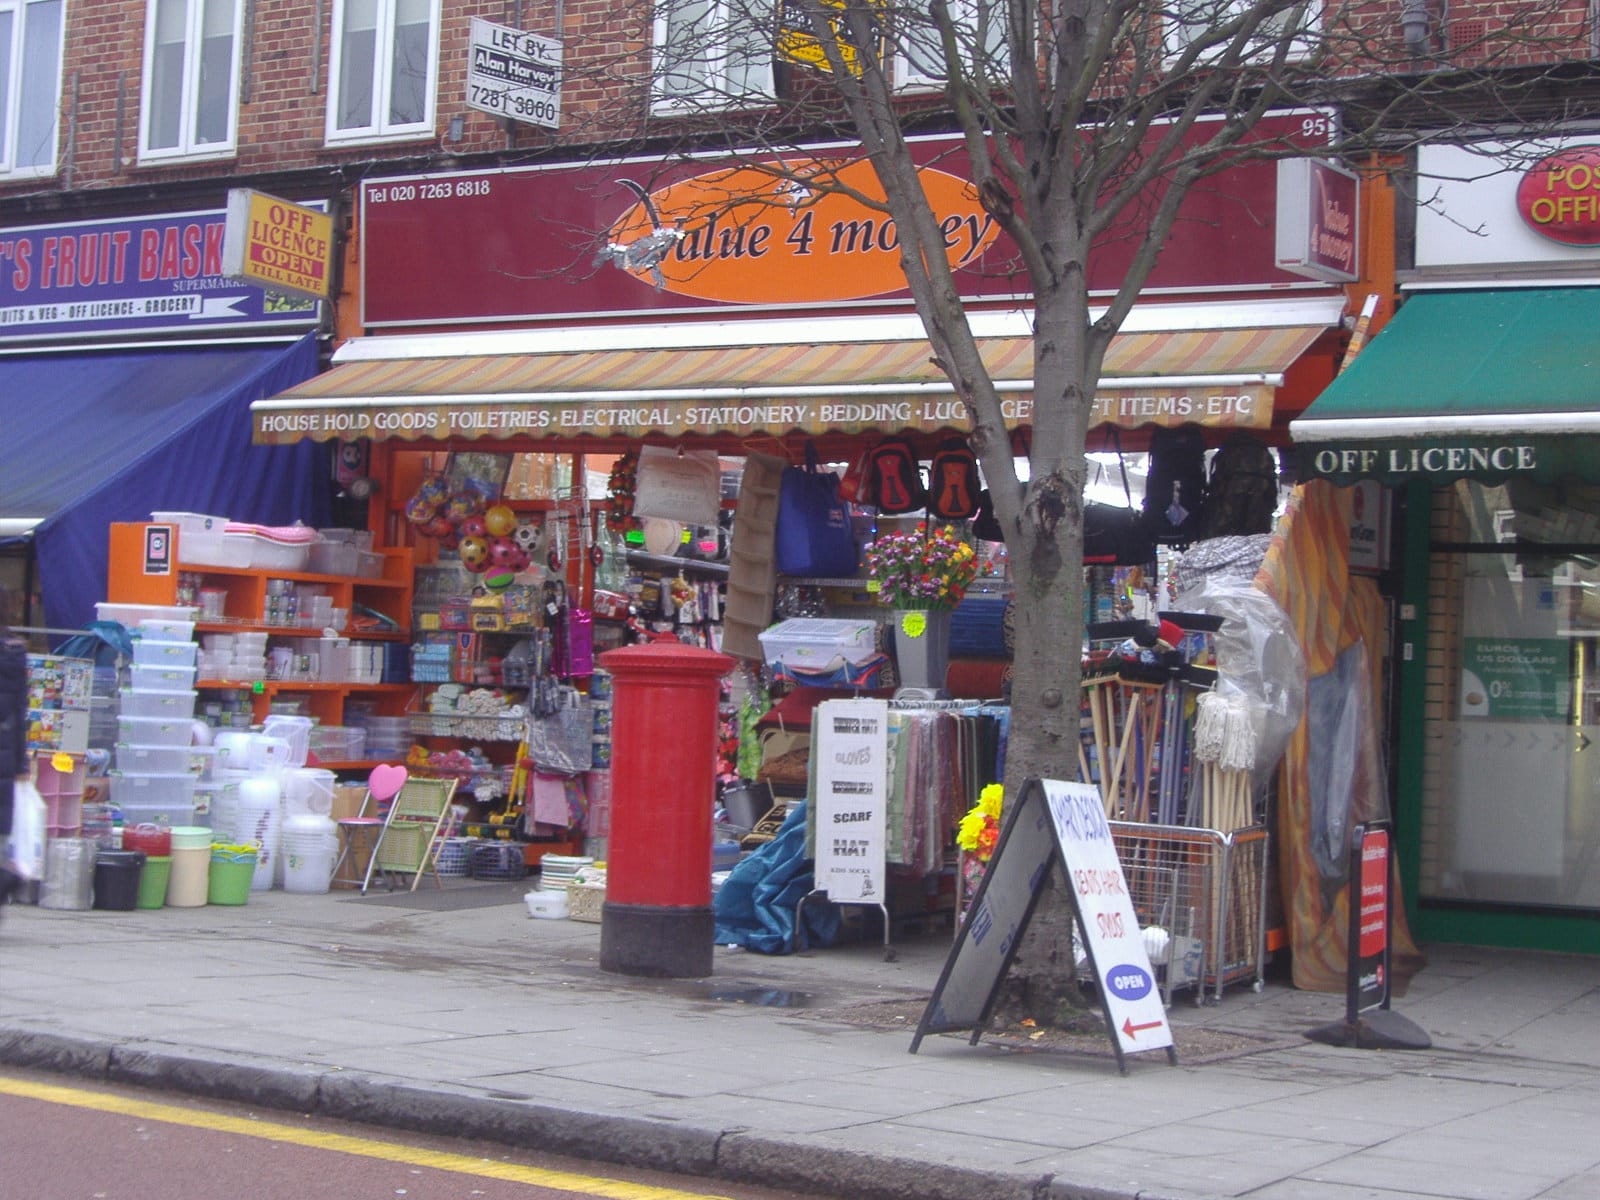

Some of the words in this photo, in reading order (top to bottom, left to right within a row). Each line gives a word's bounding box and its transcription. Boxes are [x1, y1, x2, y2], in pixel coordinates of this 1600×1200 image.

[492, 29, 520, 52] LET
[526, 39, 546, 59] BY
[476, 48, 505, 71] Alan
[509, 57, 554, 91] Harvey
[471, 85, 508, 112] 7281
[515, 96, 555, 121] 3000
[1302, 118, 1326, 137] 95
[368, 188, 387, 203] Tel
[390, 186, 416, 201] 020
[420, 183, 453, 199] 7263
[456, 180, 490, 197] 6818
[269, 205, 313, 234] OFF
[252, 220, 327, 260] LICENCE
[786, 211, 814, 255] 4
[830, 213, 993, 265] moey
[41, 230, 130, 289] FRUIT
[261, 247, 313, 276] OPEN
[252, 263, 283, 281] TILL
[287, 273, 321, 291] LATE
[39, 306, 57, 321] VEG
[69, 304, 88, 319] OFF
[90, 301, 134, 317] LICENCE
[145, 297, 196, 314] GROCERY
[261, 413, 320, 432] HOUSE
[324, 412, 371, 430] HOLD
[374, 411, 438, 429] GOODS
[448, 410, 550, 429] TOILETRIES
[560, 408, 674, 427] ELECTRICAL
[684, 405, 809, 425] STATIONERY
[820, 402, 912, 422] BEDDING
[1119, 396, 1192, 416] ITEMS
[1206, 395, 1253, 415] ETC
[1314, 449, 1378, 473] OFF
[1388, 446, 1537, 473] LICENCE
[835, 745, 871, 766] GLOVES
[833, 811, 872, 824] SCARF
[1114, 974, 1144, 991] OPEN
